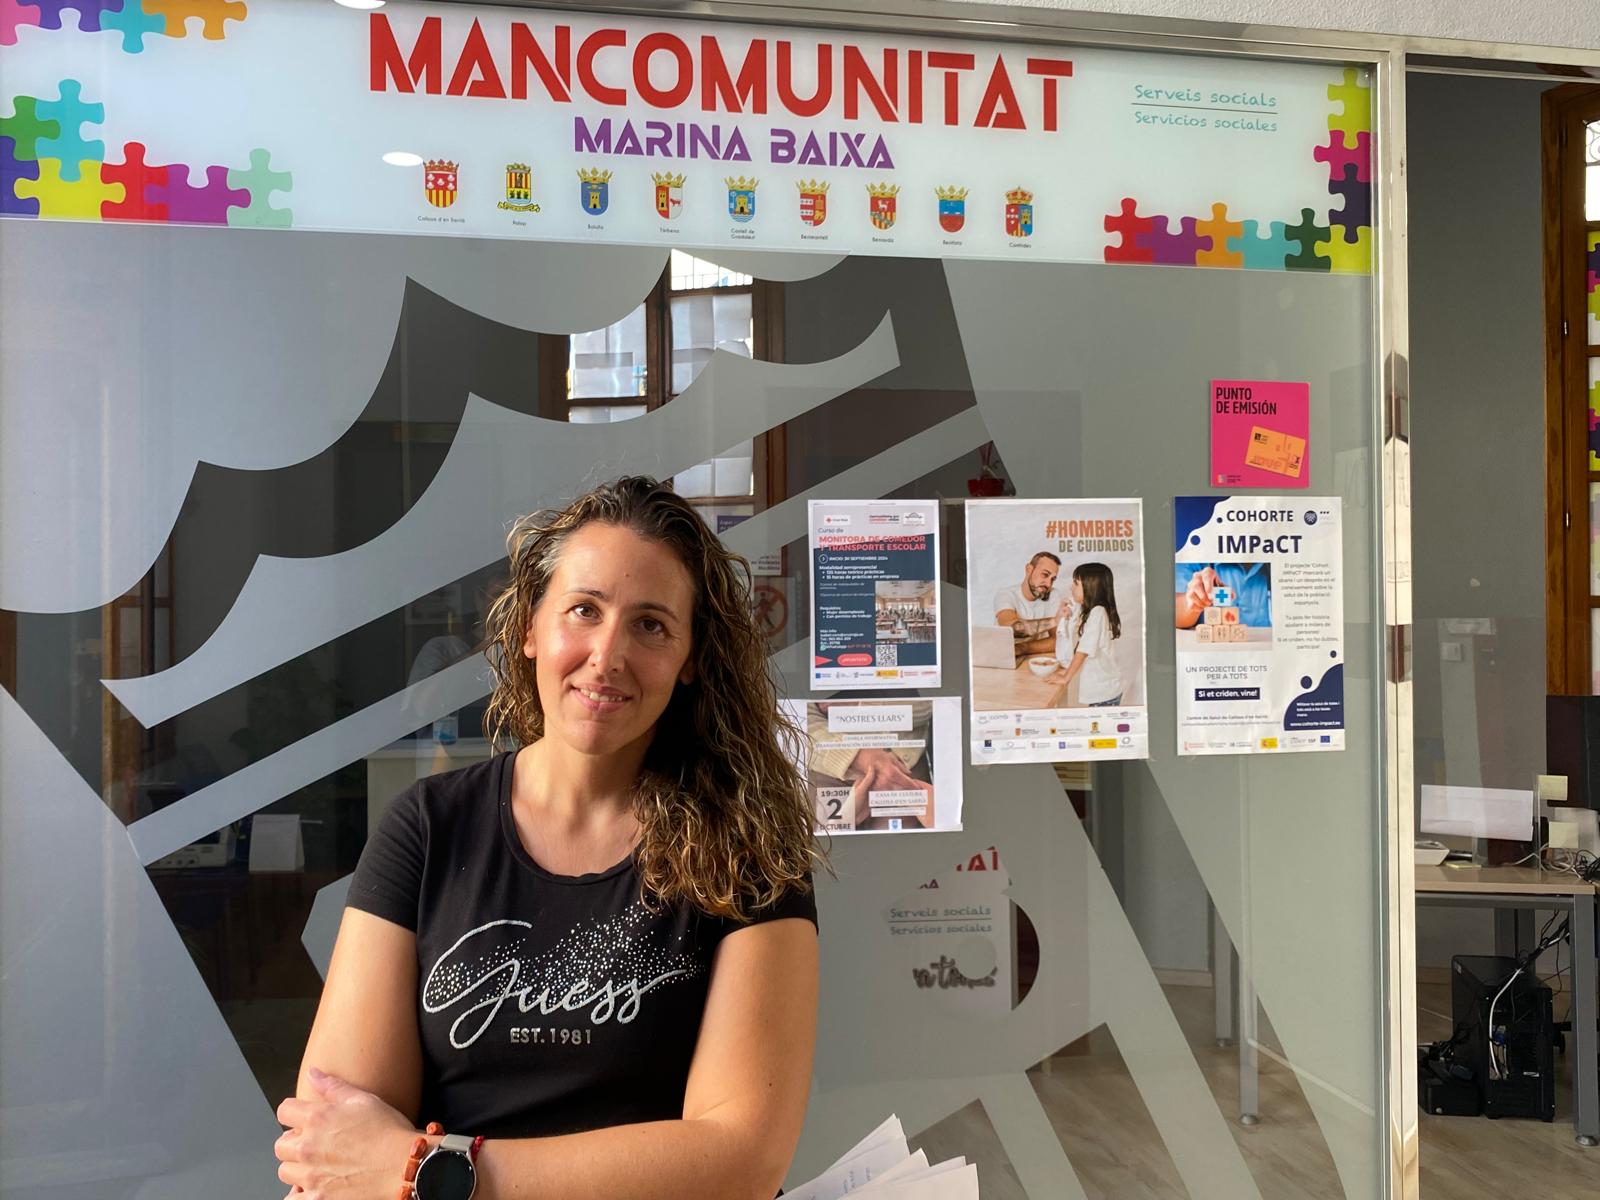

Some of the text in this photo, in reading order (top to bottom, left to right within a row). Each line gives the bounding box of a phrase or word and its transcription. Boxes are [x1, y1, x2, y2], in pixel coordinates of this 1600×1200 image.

[370, 13, 1073, 132] MANCOMUNITAT
[1134, 84, 1277, 107] Serveis socials
[1134, 111, 1278, 132] Servicios sociales
[574, 116, 895, 169] MARINA BAIXA
[1216, 387, 1252, 400] PUNTO
[1216, 399, 1277, 415] DE EMISIÓN
[1226, 510, 1294, 522] COHORTE
[1046, 520, 1134, 538] #HOMBRES
[819, 535, 866, 543] MONITORA
[883, 535, 926, 543] COMEDOR
[1059, 539, 1134, 552] DE CUIDADOS
[1217, 535, 1303, 554] IMPaCT
[828, 543, 885, 551] TRANSPORTE
[887, 543, 926, 551] ESCOLAR
[1199, 665, 1236, 673] PROJECTE
[1198, 690, 1205, 698] Si
[1206, 690, 1215, 698] et
[1240, 689, 1258, 697] vine!
[827, 799, 843, 820] 2
[890, 905, 991, 919] Serveis socials
[890, 923, 992, 935] Servicios sociales
[423, 919, 687, 1049] Guess
